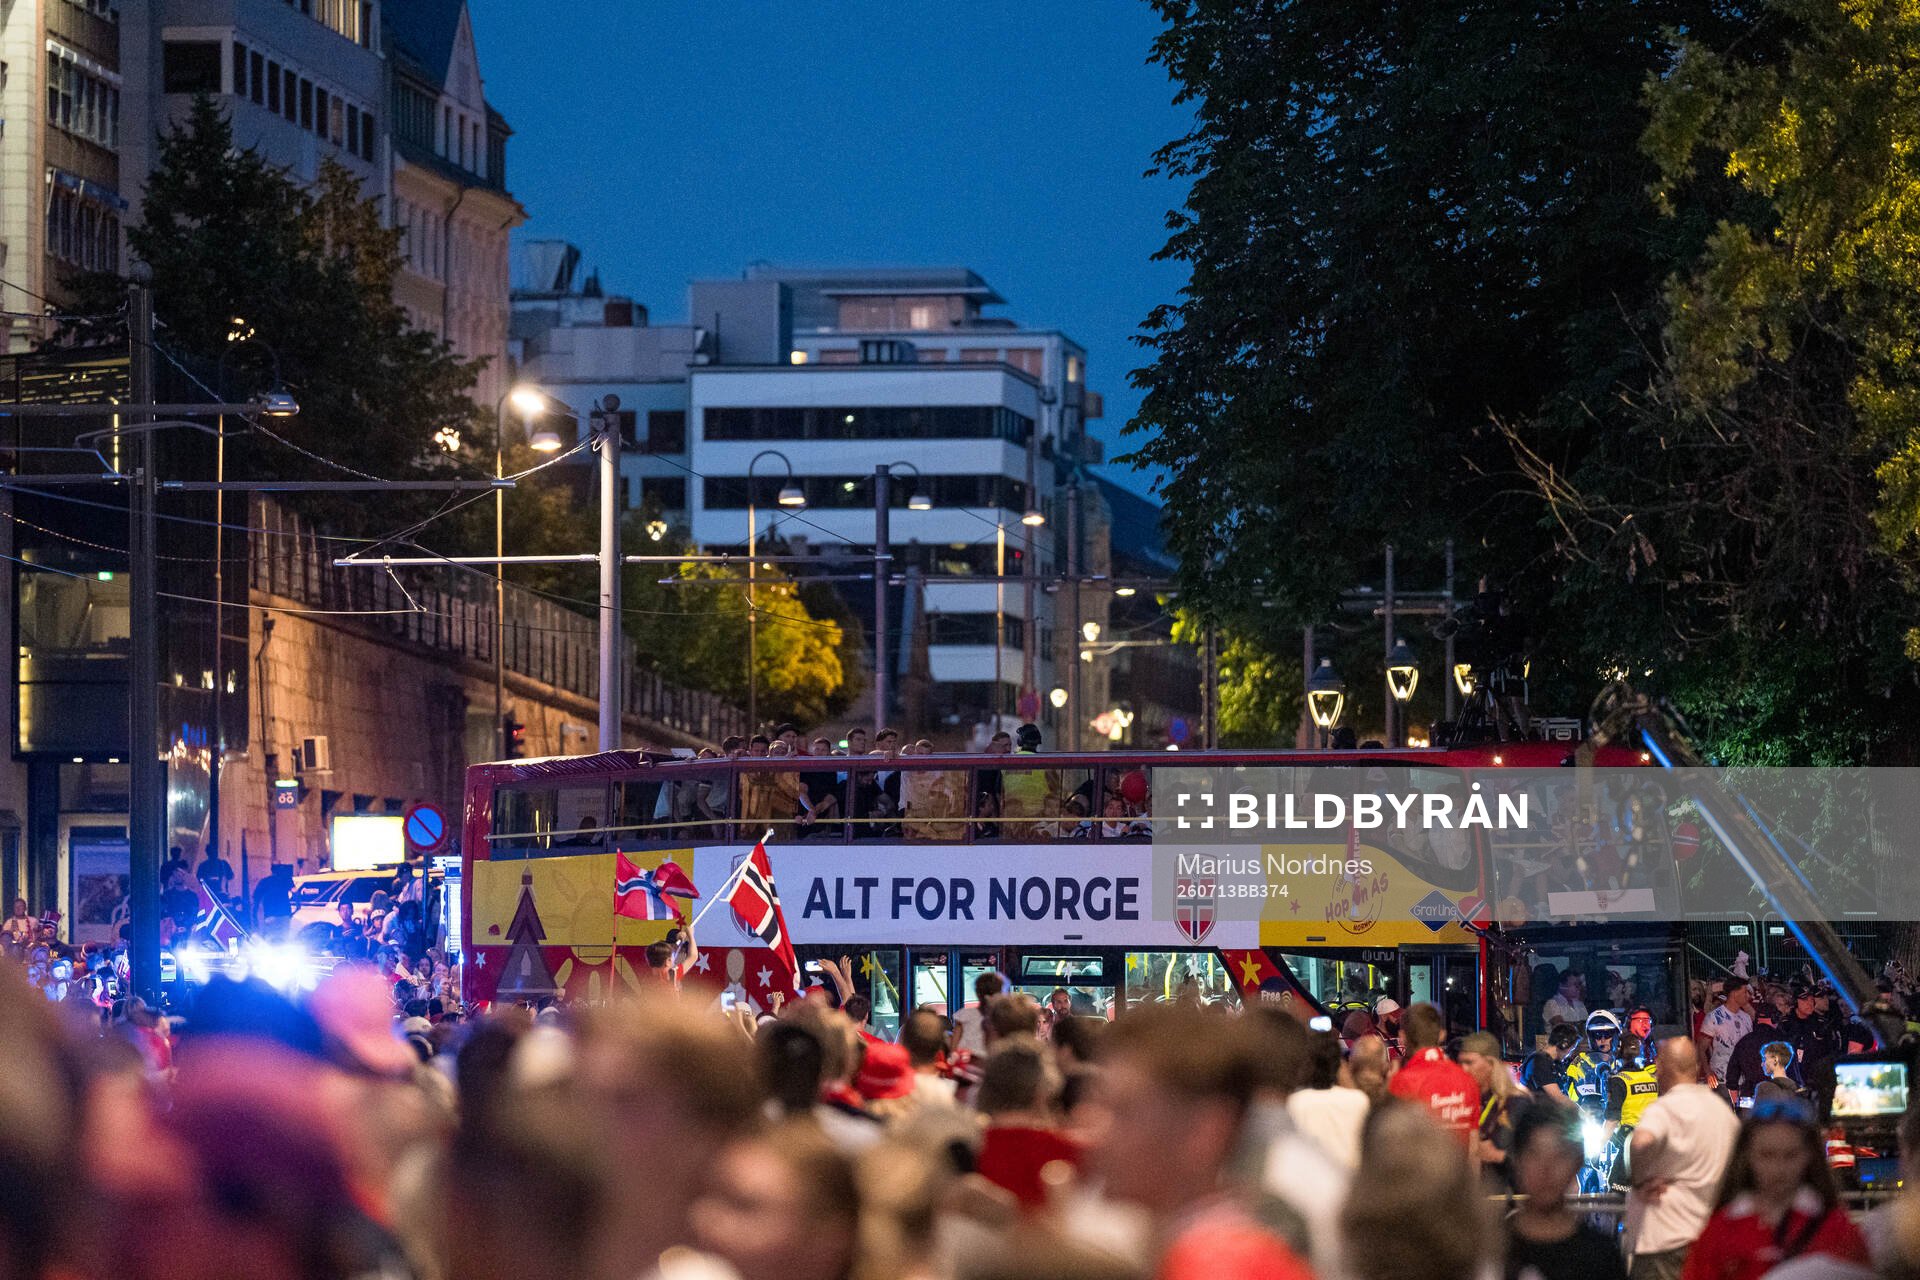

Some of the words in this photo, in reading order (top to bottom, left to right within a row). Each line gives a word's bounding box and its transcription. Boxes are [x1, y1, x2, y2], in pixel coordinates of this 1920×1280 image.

[1372, 872, 1389, 898] AS
[802, 877, 879, 919] ALT
[891, 877, 975, 920] FOR
[989, 876, 1140, 921] NORGE
[1260, 990, 1281, 1002] Free
